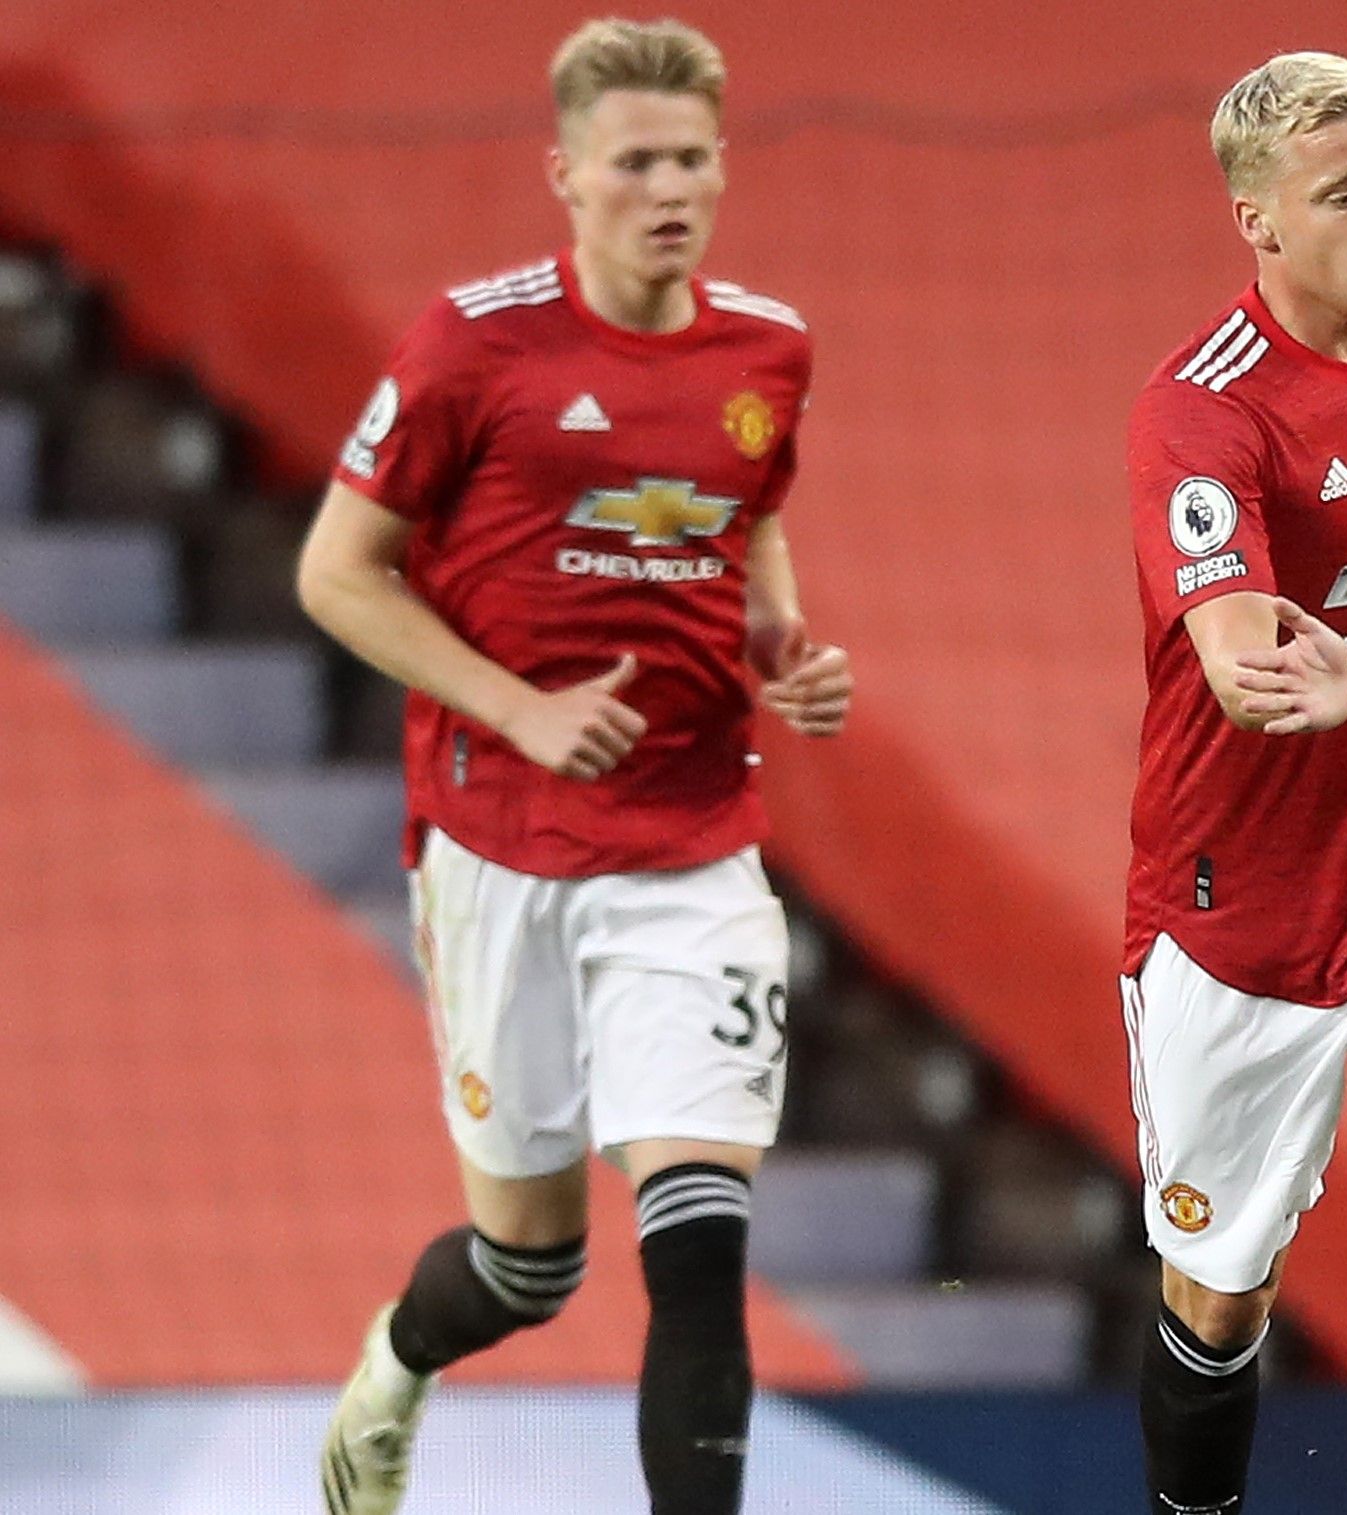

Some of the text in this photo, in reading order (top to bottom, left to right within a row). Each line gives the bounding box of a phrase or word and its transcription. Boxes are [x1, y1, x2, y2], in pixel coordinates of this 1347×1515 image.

[556, 548, 726, 583] CHEVROLET
[1176, 553, 1238, 581] No room
[1178, 563, 1247, 597] for racism
[711, 965, 788, 1064] 39
